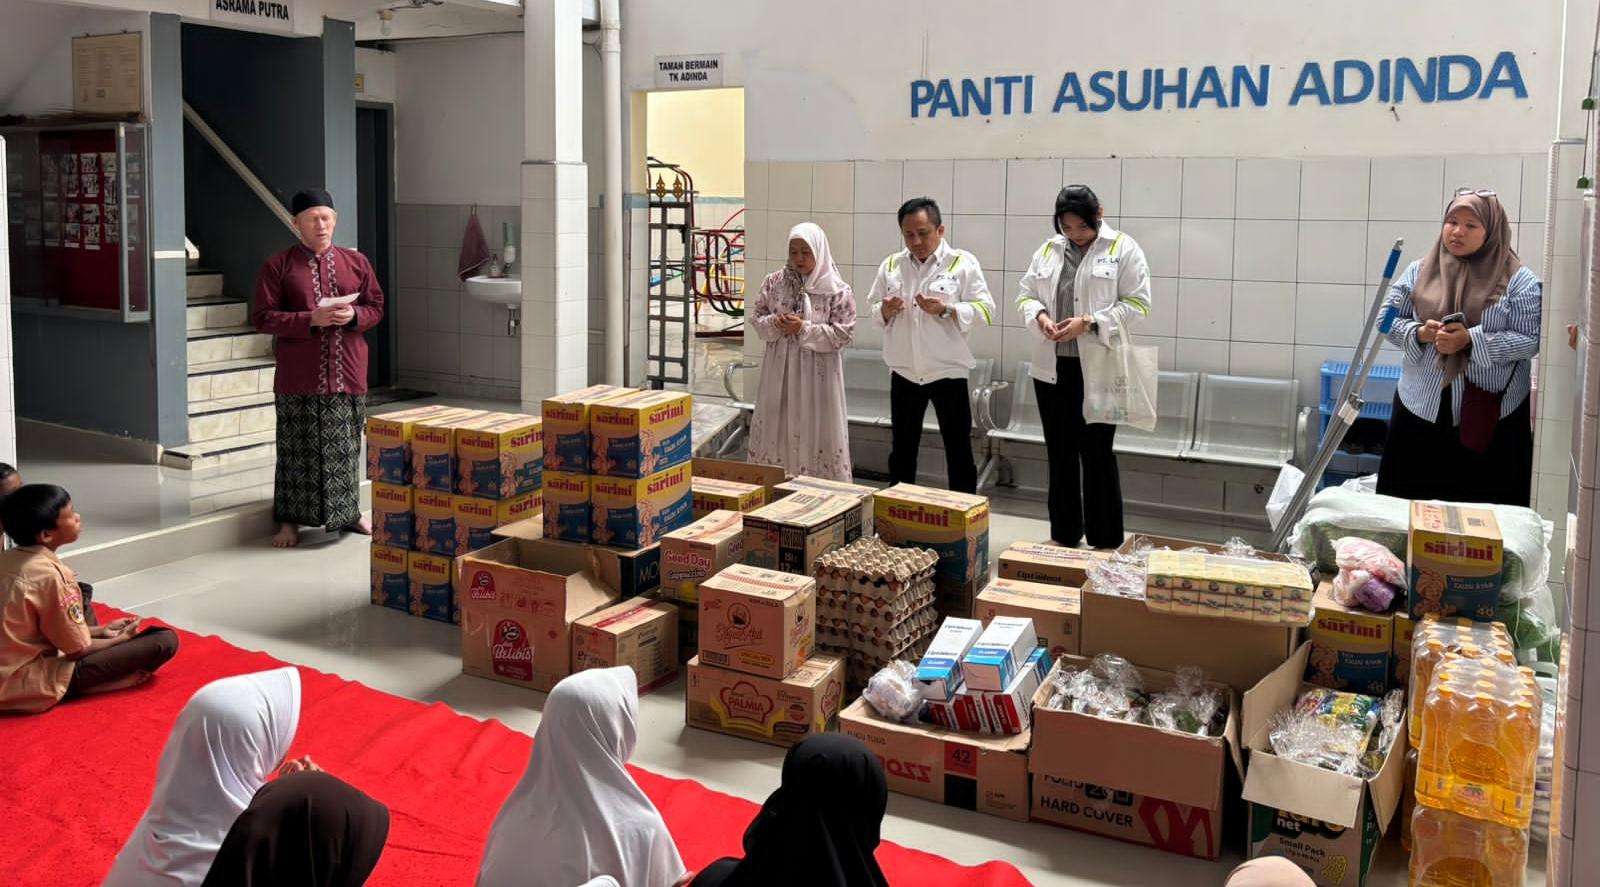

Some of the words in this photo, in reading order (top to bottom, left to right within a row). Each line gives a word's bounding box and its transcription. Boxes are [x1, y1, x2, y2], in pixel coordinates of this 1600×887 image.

[216, 0, 256, 15] ASRAMA
[259, 1, 289, 20] PUTRA
[659, 61, 683, 70] TAMAN
[685, 60, 718, 70] BERMAIN
[669, 72, 679, 81] TK
[680, 71, 707, 81] ADINDA
[910, 75, 1034, 118] PANTI
[1052, 65, 1270, 113] ASUHAN
[1288, 51, 1529, 106] ADINDA
[545, 408, 580, 421] sarimi
[596, 411, 636, 426] sarimi
[649, 400, 684, 425] sarimi
[370, 424, 400, 438] sarimi
[415, 431, 447, 444] sarimi
[511, 429, 543, 448] sarim
[461, 436, 495, 449] sarimi
[547, 479, 584, 492] sarimi
[596, 481, 634, 496] sarimi
[647, 468, 684, 495] sarimi
[376, 488, 407, 502] sarimi
[458, 502, 492, 517] sarimi
[509, 496, 543, 515] sarim
[888, 505, 949, 527] sarimi
[374, 549, 403, 564] sarimi
[1424, 542, 1493, 560] sarimi
[413, 559, 445, 574] sarimi
[664, 550, 690, 565] Good
[692, 554, 711, 570] Day
[1318, 619, 1382, 639] sarimi
[728, 696, 764, 712] PALMIA
[952, 749, 970, 763] 42
[1040, 796, 1080, 814] HARD
[1083, 806, 1133, 827] COVER
[1276, 817, 1301, 832] net
[1280, 838, 1304, 849] Small
[1305, 844, 1326, 857] Pack
